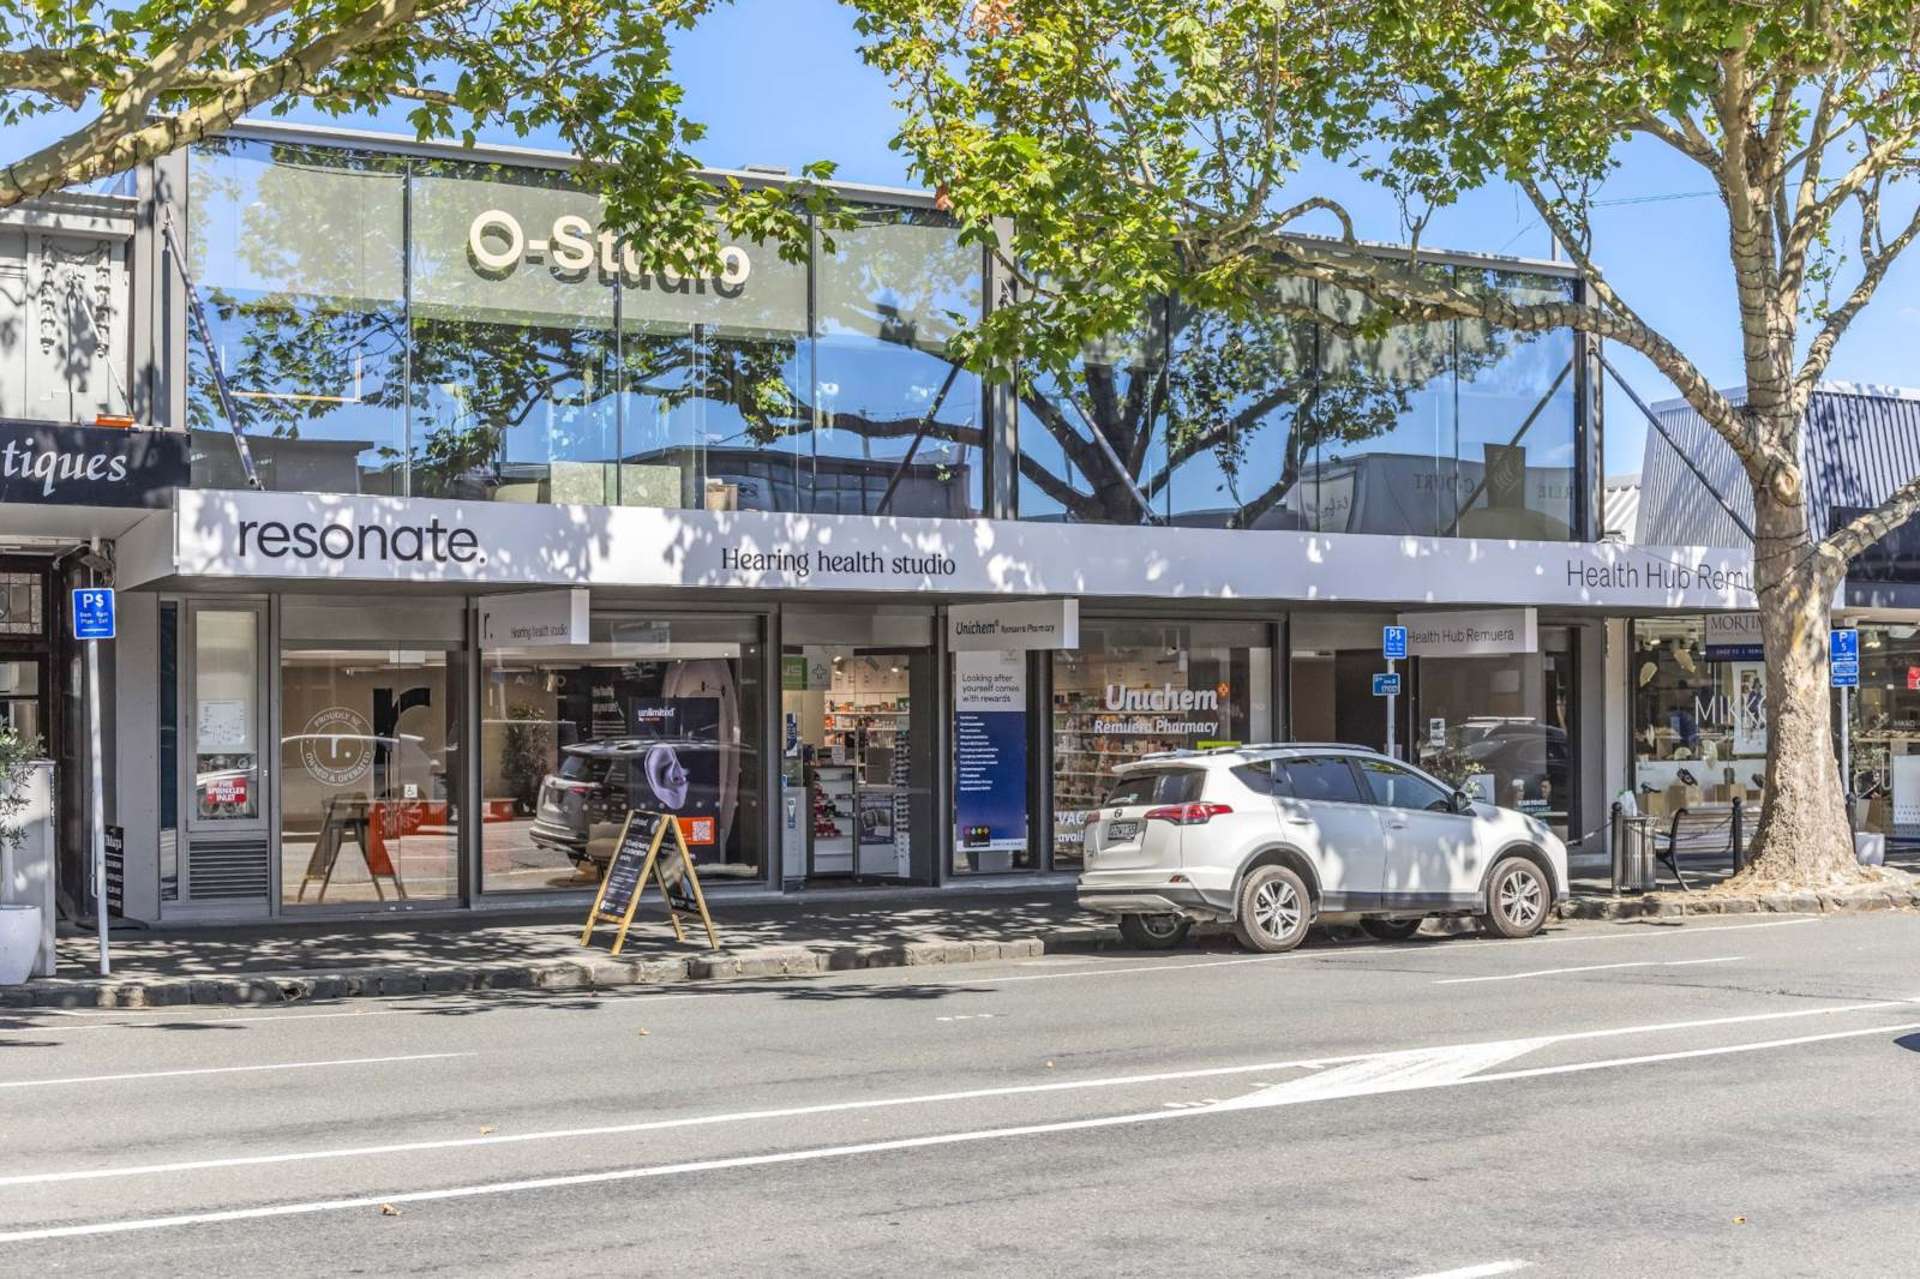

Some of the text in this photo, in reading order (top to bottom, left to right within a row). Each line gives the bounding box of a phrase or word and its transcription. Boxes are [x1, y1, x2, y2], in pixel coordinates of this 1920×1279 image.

[1, 437, 127, 497] tiques
[238, 518, 487, 564] resonate.
[721, 547, 956, 577] Hearing health studio
[1567, 559, 1639, 589] Health
[1647, 562, 1691, 590] Hub
[955, 621, 996, 636] Unichem
[1442, 628, 1465, 643] Hub
[1466, 627, 1515, 642] Remuera
[962, 673, 993, 685] Looking
[962, 683, 994, 694] yourself
[1105, 683, 1218, 712] Unichem
[1094, 719, 1218, 736] Remuera Pharmacy
